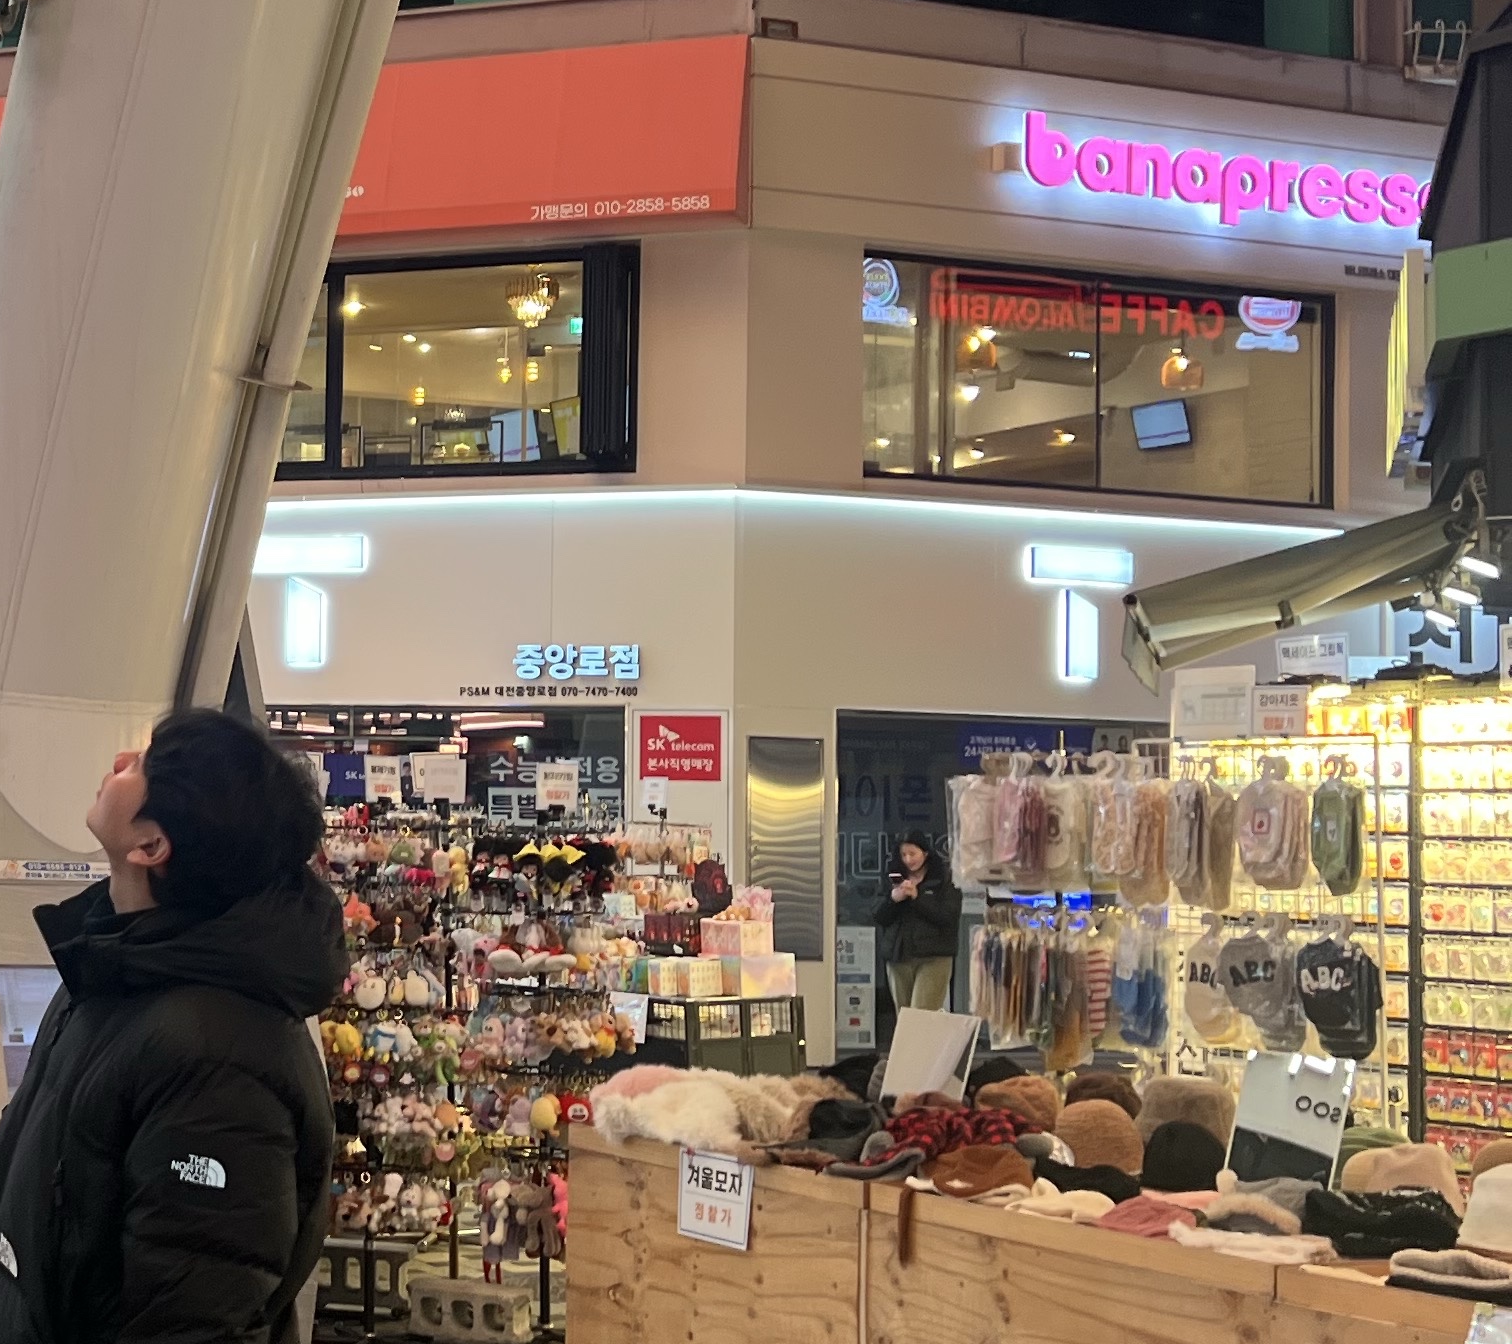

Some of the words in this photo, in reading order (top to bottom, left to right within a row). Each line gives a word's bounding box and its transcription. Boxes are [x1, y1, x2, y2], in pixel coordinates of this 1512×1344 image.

[530, 203, 588, 221] 가맹문의
[593, 194, 710, 217] 010-2858-5858
[512, 643, 641, 680] 중앙로점
[459, 686, 491, 697] PS&M
[495, 686, 558, 698] 대전중앙로점
[561, 686, 639, 698] 070-7470-7400
[647, 736, 666, 751] SK
[670, 739, 715, 752] telecom
[647, 757, 714, 772] 본사직영매장
[1228, 959, 1277, 987] ABC
[1299, 964, 1346, 995] ABC
[171, 1159, 208, 1175] NORTH
[189, 1154, 209, 1167] THE
[179, 1171, 206, 1185] FACE
[687, 1163, 743, 1197] 겨울모자
